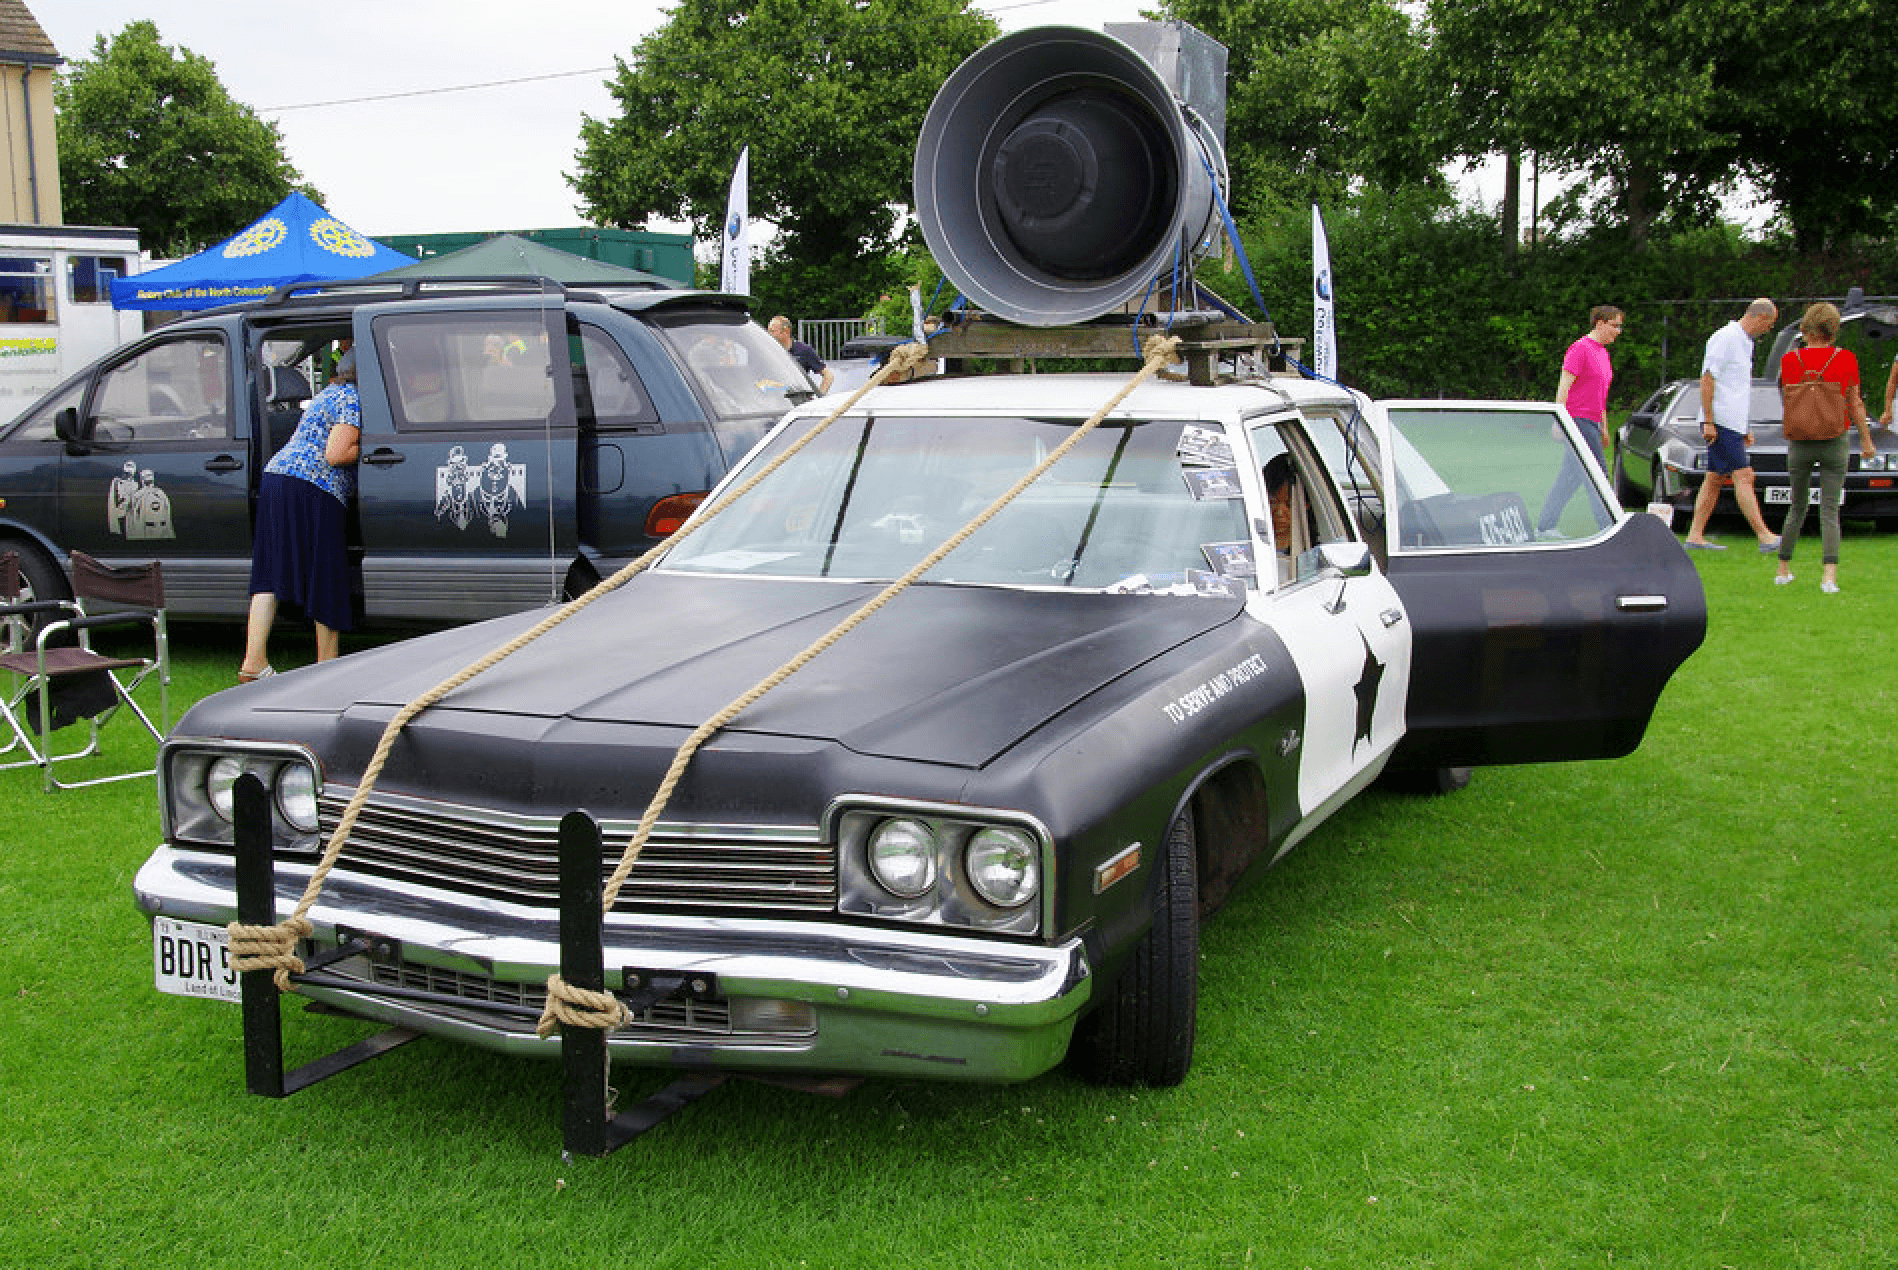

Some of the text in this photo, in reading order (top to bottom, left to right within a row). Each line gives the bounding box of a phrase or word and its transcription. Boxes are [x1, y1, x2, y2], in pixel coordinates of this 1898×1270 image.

[137, 289, 162, 301] Rotary
[163, 288, 183, 299] Club
[185, 287, 193, 299] of
[195, 287, 207, 298] the
[208, 286, 231, 297] North
[1162, 653, 1268, 724] TO SERVE AND PROTECT
[160, 935, 237, 985] BDR 5
[184, 981, 207, 996] Land
